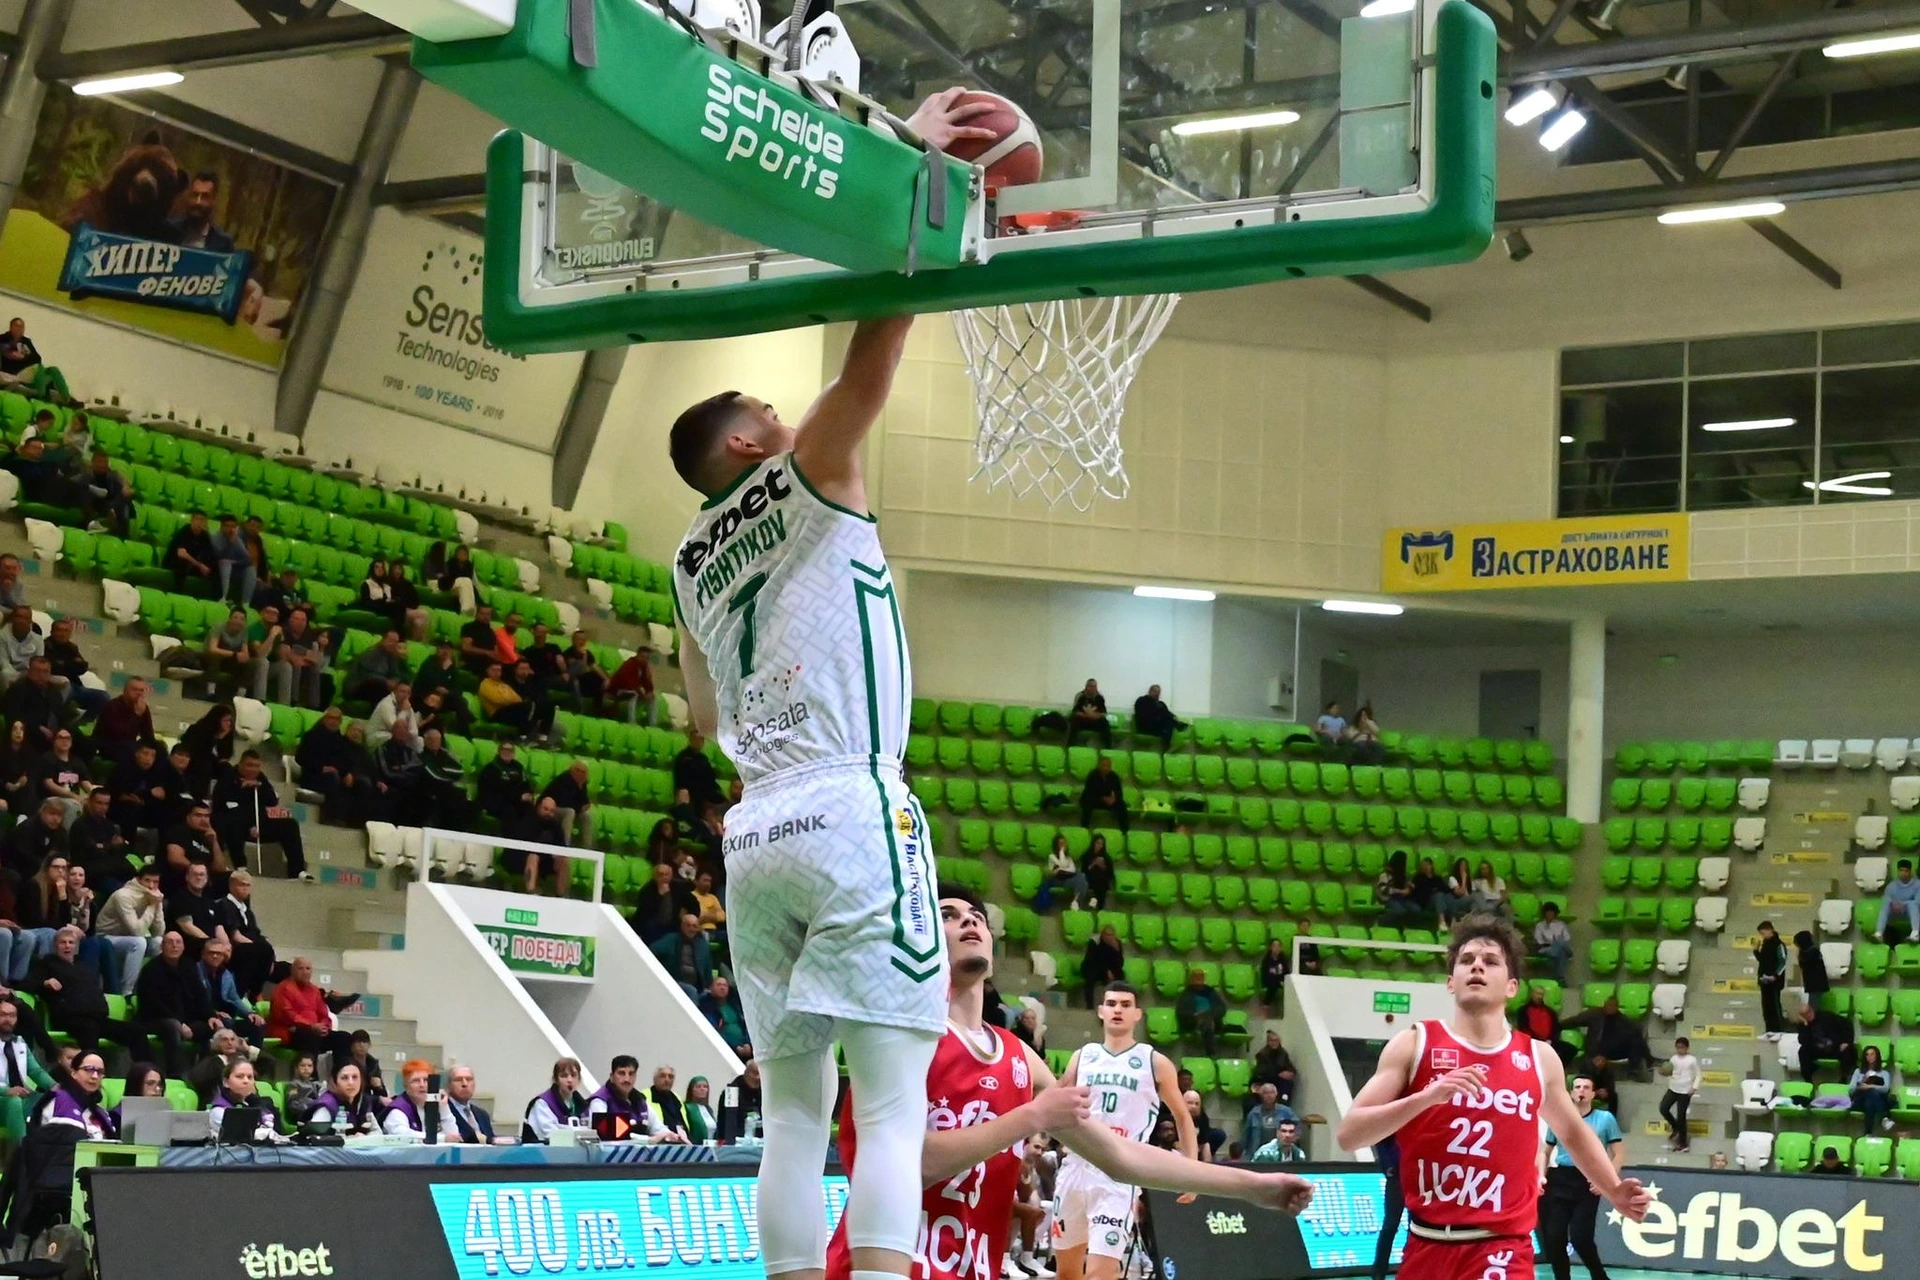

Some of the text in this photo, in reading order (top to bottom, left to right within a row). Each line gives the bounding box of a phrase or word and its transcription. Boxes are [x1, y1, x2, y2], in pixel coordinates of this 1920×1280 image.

[707, 64, 844, 164] Schelde
[701, 101, 839, 199] Sports
[85, 241, 181, 278] ХИПЕР
[137, 275, 226, 297] ФЕНОВЕ
[396, 332, 500, 383] Technologies
[436, 389, 474, 413] YEARS
[676, 467, 792, 578] efbet
[1472, 537, 1669, 578] ЗАСТРАХОВАНЕ
[768, 814, 827, 843] BANK
[511, 934, 582, 968] ПОБЕДА!
[1086, 1073, 1139, 1092] BALKAN
[1101, 1091, 1118, 1113] 10
[1446, 1117, 1494, 1158] 22
[463, 1188, 568, 1275] 400
[635, 1184, 761, 1268] БОНУ
[1092, 1214, 1123, 1228] efbet
[1621, 1190, 1884, 1272] efbet
[244, 1241, 334, 1279] efbet
